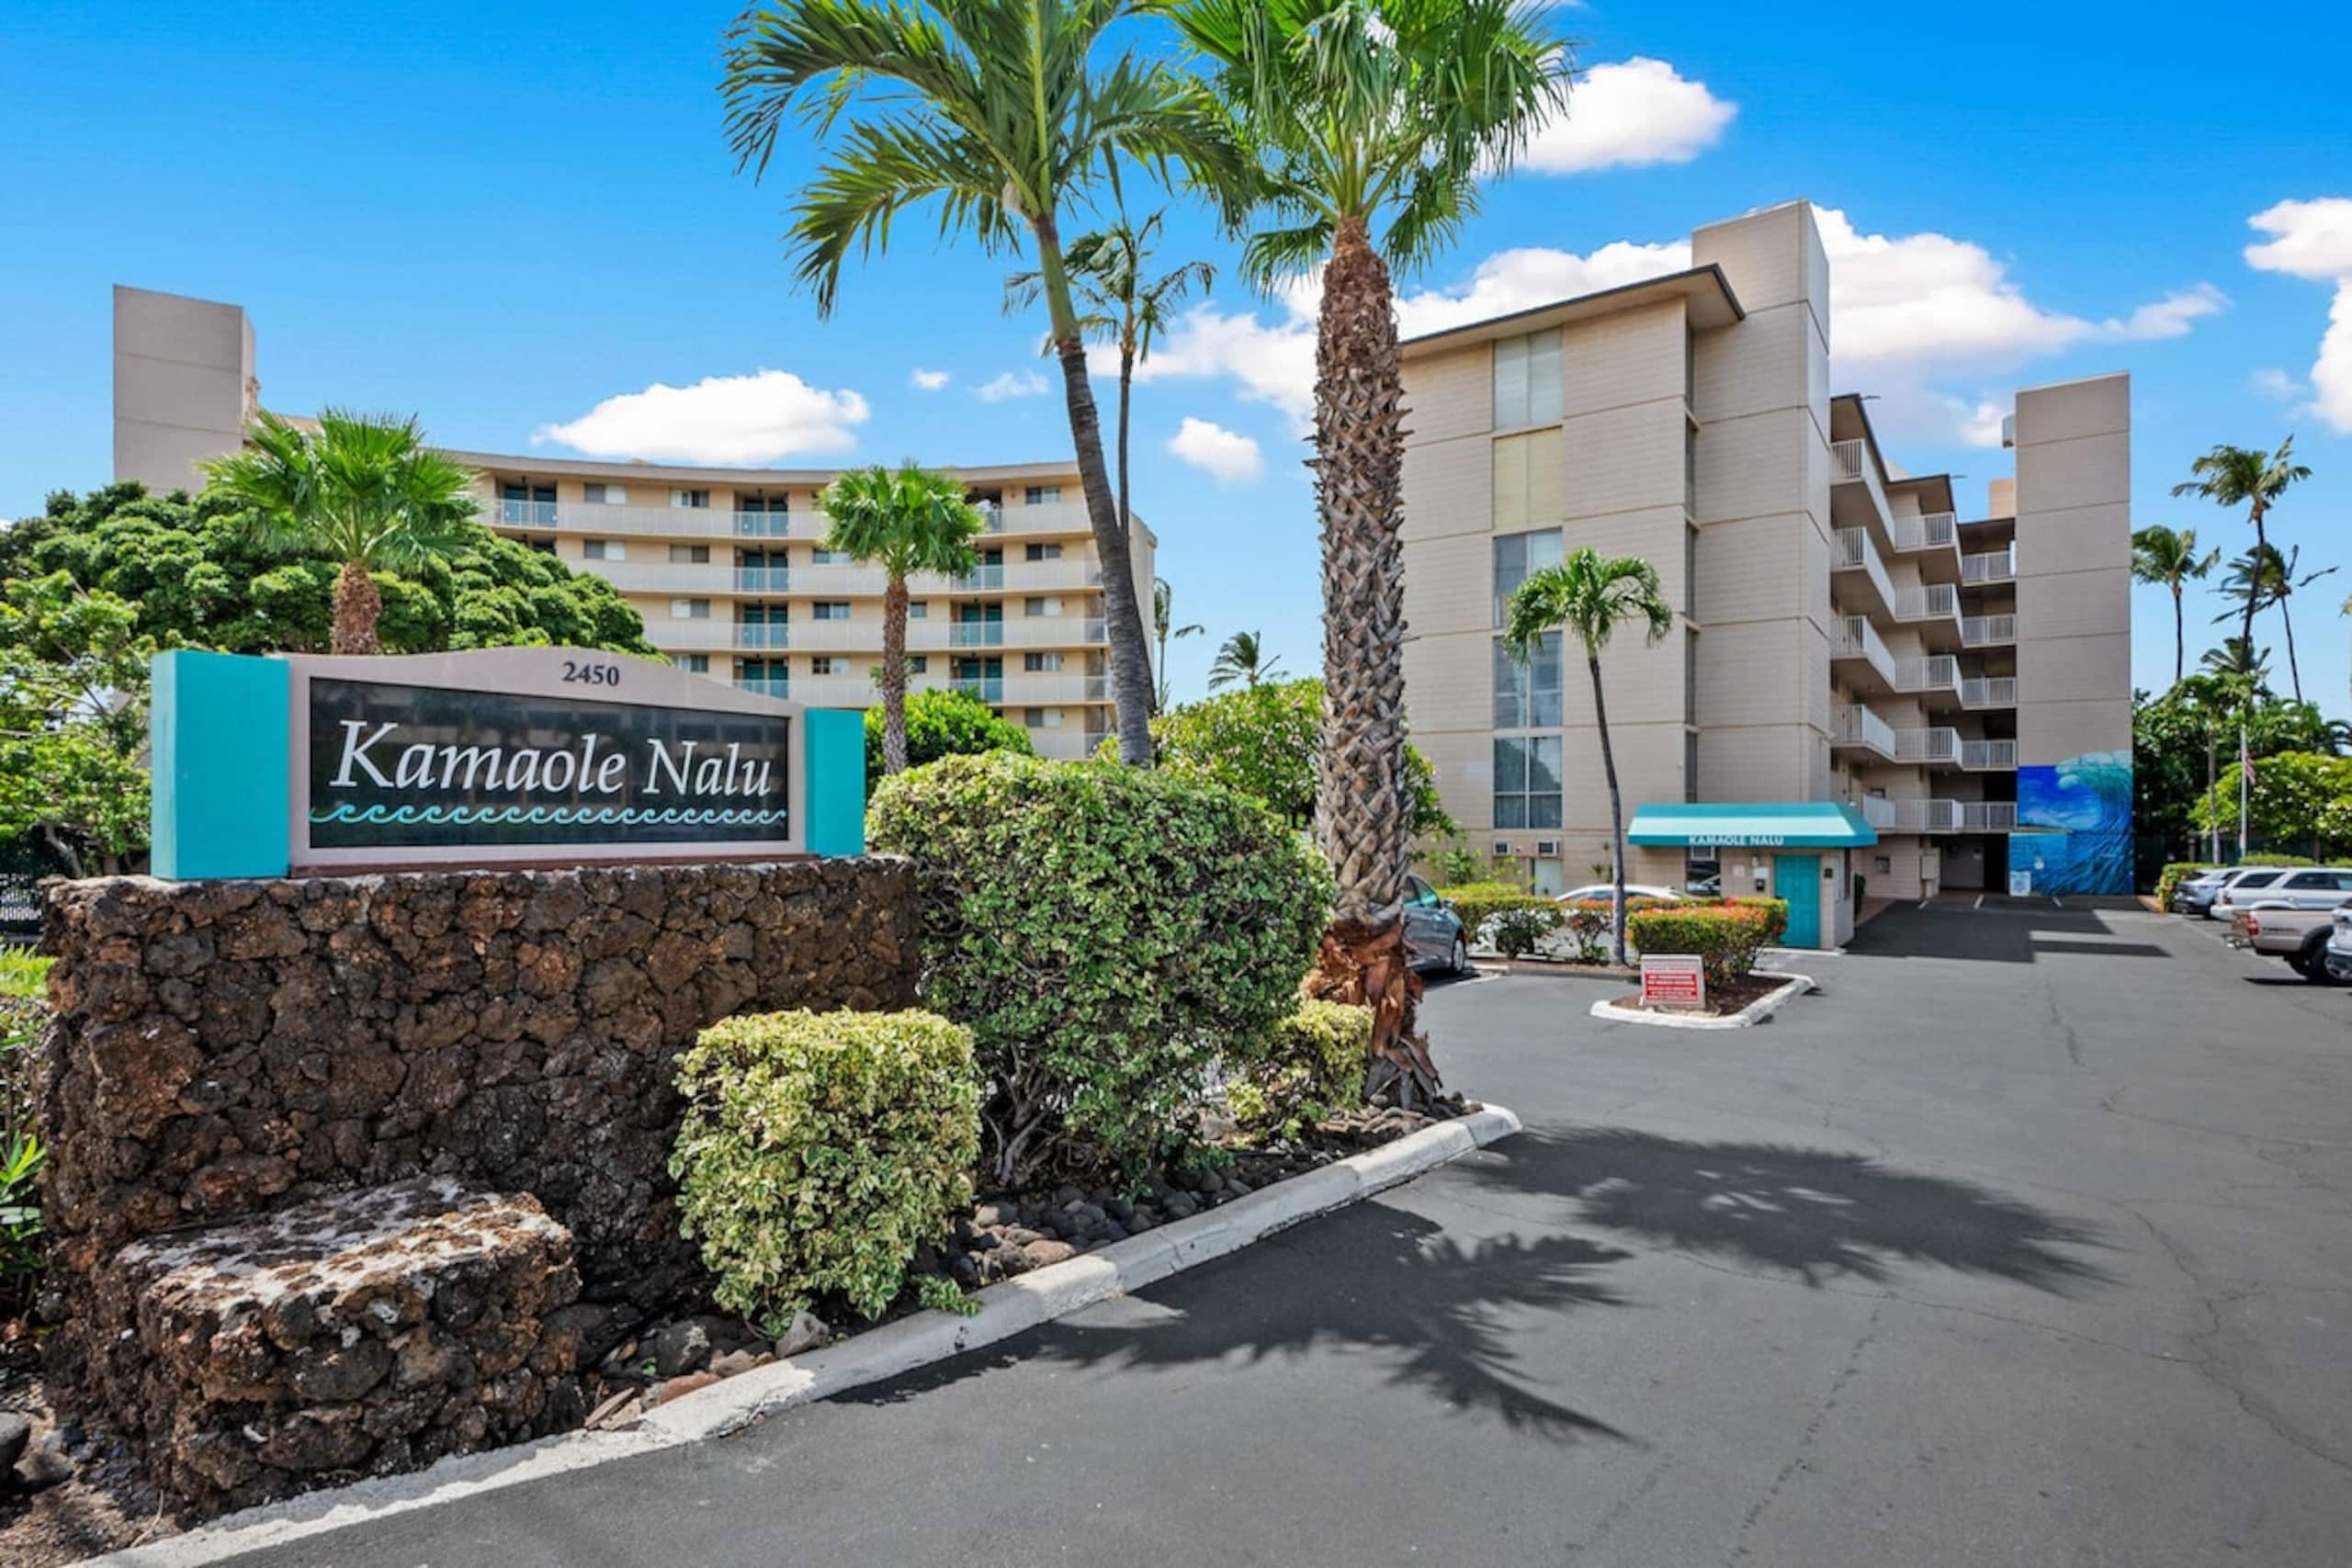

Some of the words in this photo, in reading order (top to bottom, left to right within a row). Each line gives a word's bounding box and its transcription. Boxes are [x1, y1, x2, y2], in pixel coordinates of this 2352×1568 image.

[561, 661, 620, 686] 2450
[328, 719, 627, 795] Kamaole
[642, 738, 772, 797] Nalu
[1689, 834, 1747, 846] KAMAOLE
[1749, 834, 1784, 846] NALU
